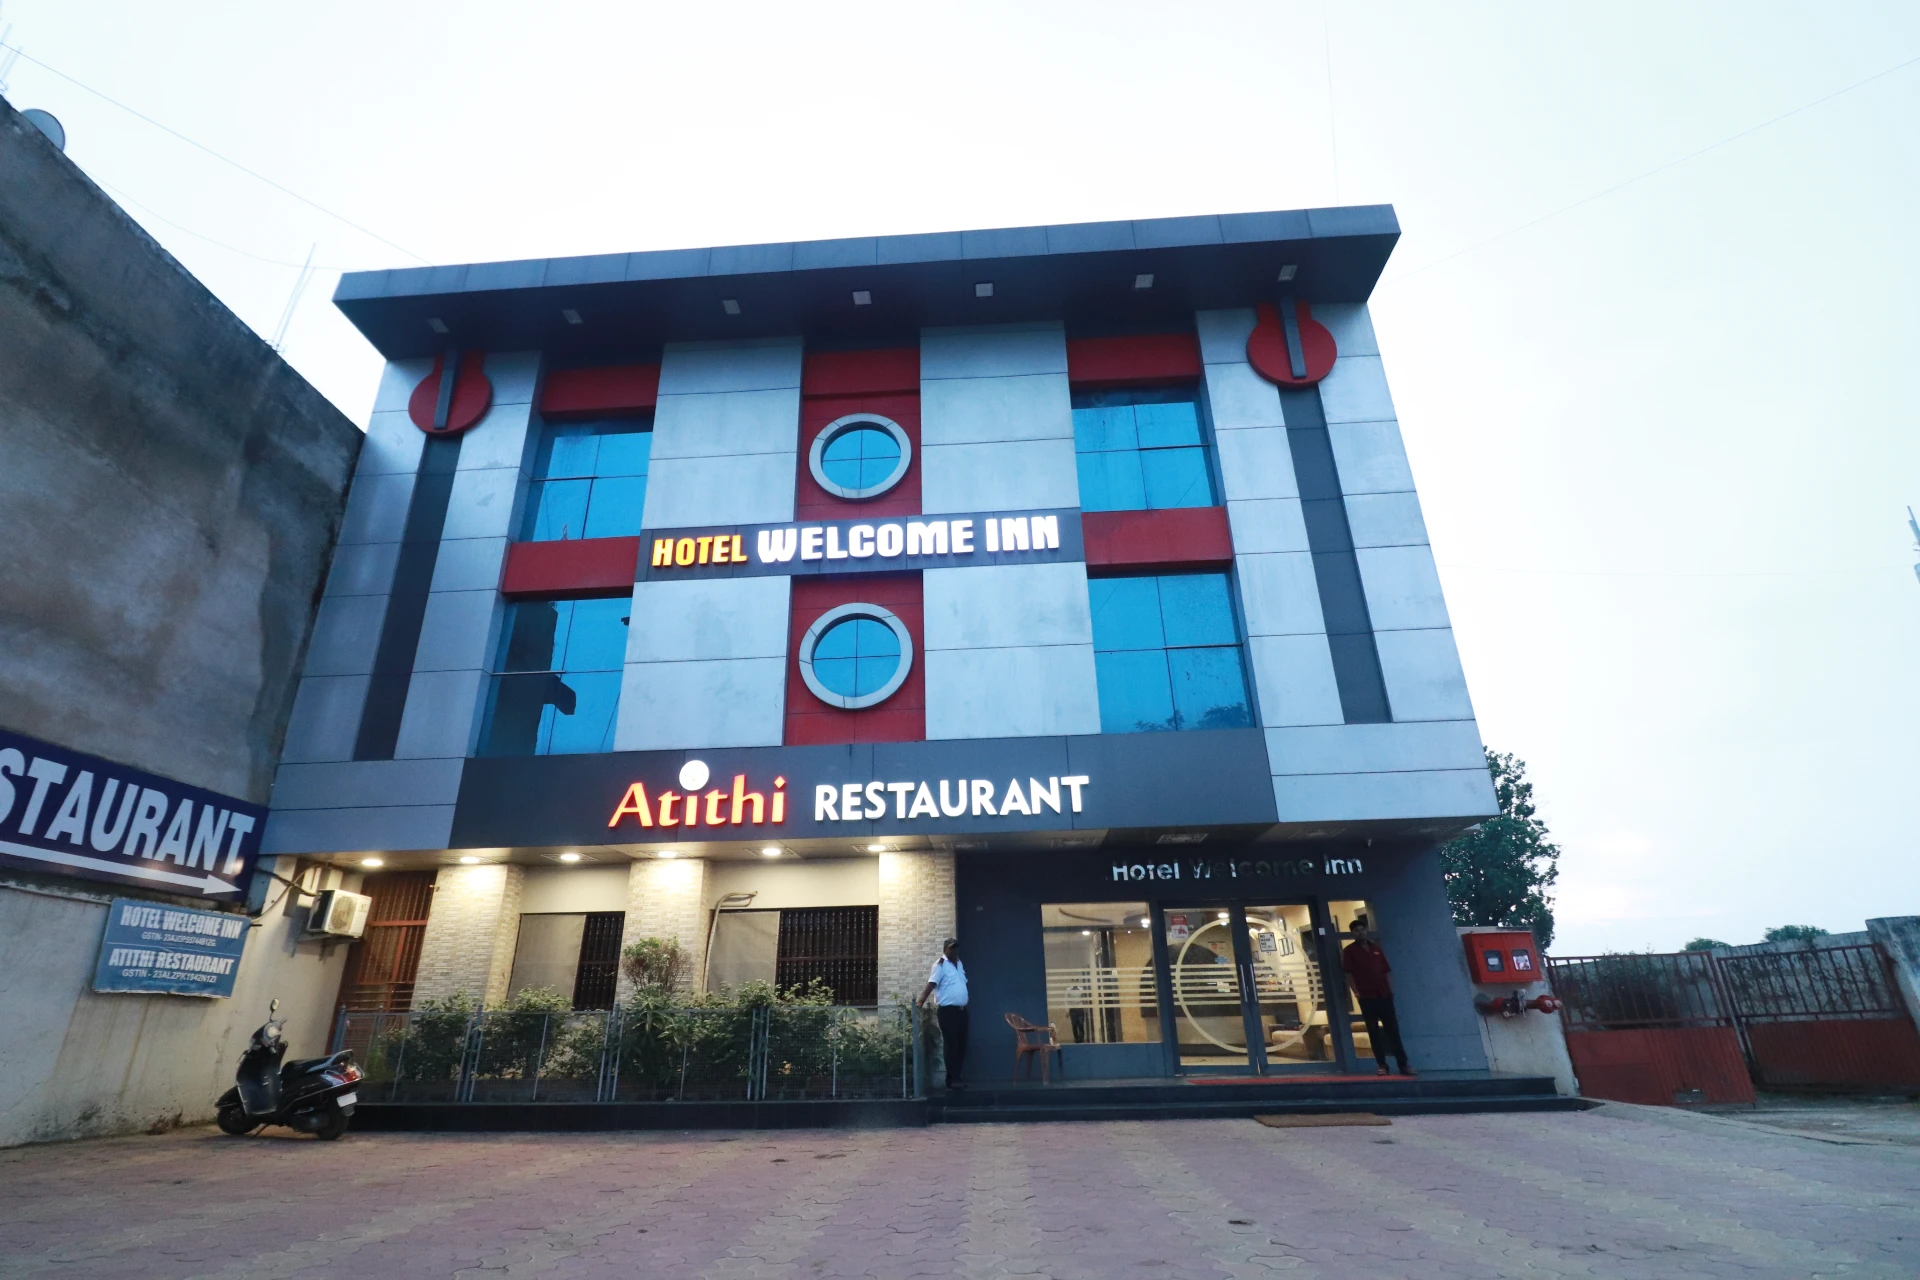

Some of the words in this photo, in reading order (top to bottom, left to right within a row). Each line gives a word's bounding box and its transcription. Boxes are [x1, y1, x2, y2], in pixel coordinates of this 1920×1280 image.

[652, 534, 747, 567] HOTEL
[757, 519, 974, 564] WELCOME
[985, 514, 1060, 553] INN
[608, 760, 788, 828] Atithi
[814, 775, 1090, 821] RESTAURANT
[1112, 859, 1180, 881] Hotel
[1323, 854, 1363, 875] Inn
[120, 905, 161, 930] HOTEL
[162, 910, 222, 936] WELCOME
[221, 918, 243, 939] INN
[108, 948, 156, 968] ATITHI
[155, 951, 235, 975] RESTAURANT
